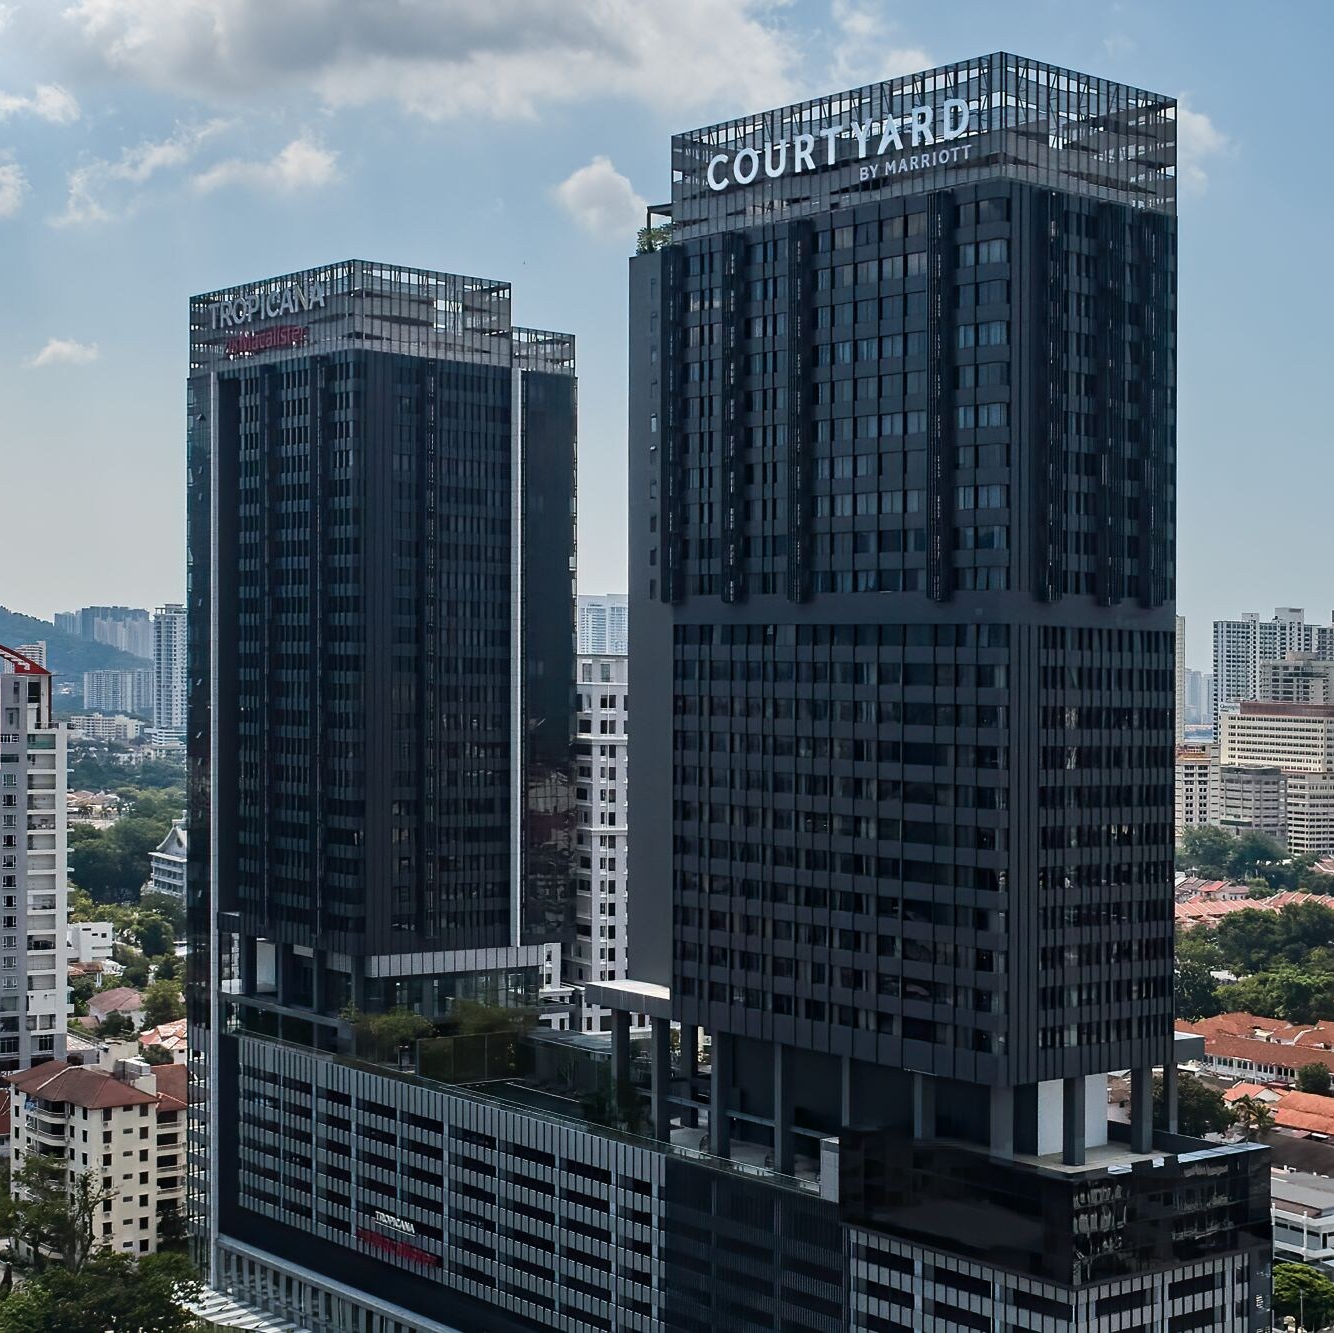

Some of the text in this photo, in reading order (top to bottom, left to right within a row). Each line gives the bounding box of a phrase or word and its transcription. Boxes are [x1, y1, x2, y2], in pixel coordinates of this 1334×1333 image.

[707, 98, 969, 191] COURTYARD
[859, 144, 972, 181] BY MARRIOTT
[208, 278, 325, 330] TROPICANA
